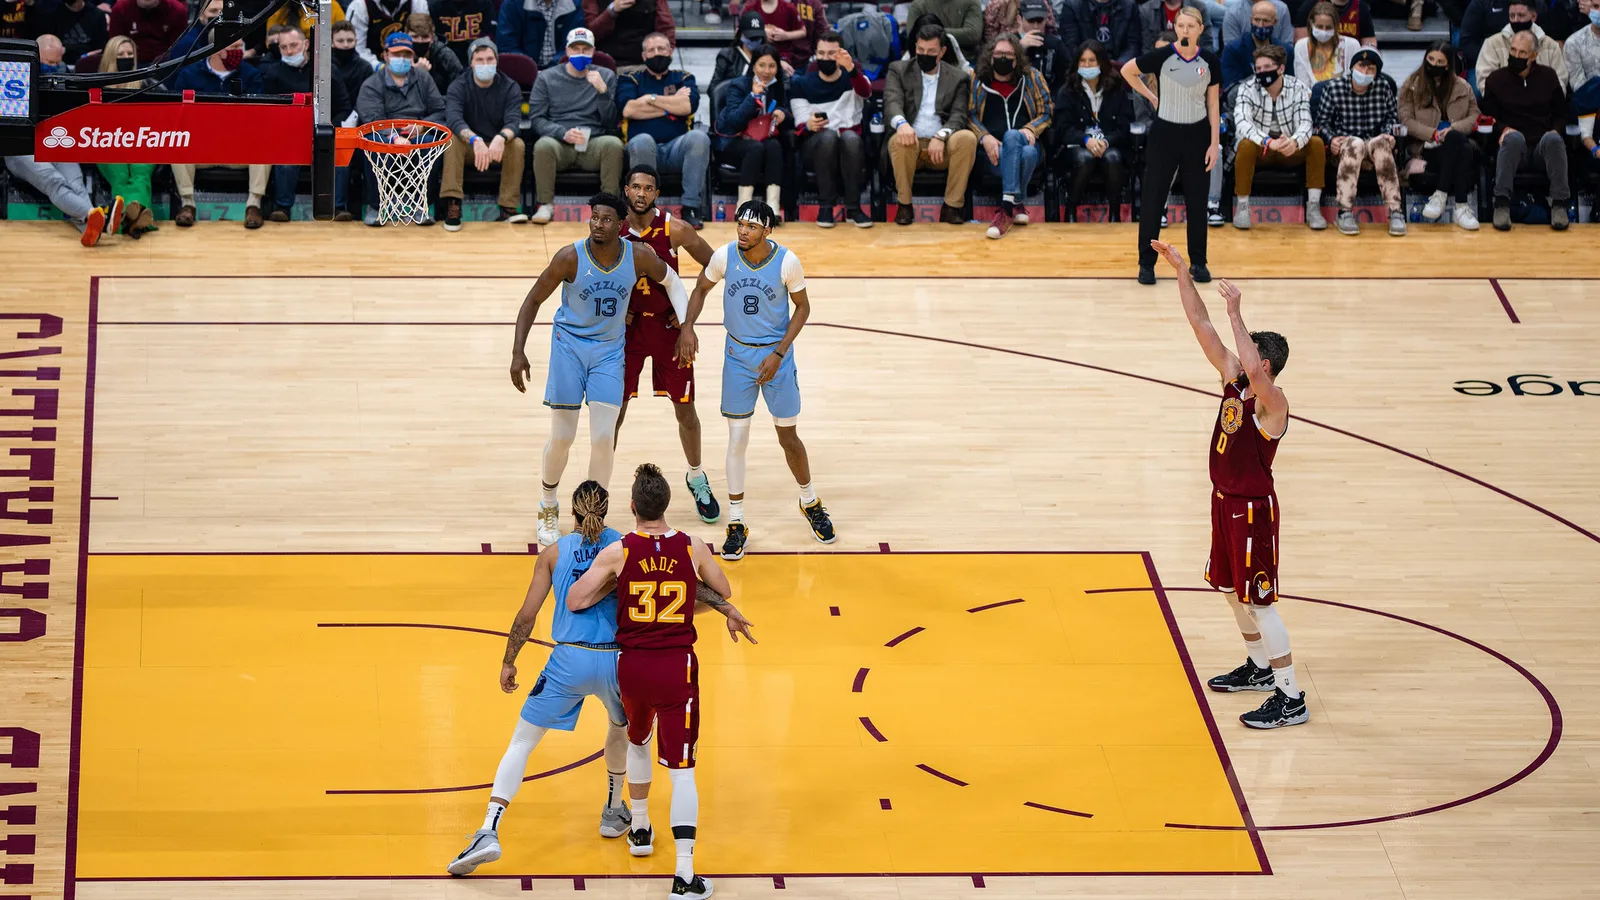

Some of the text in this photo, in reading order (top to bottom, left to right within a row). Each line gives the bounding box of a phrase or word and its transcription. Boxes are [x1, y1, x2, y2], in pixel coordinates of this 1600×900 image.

[439, 13, 483, 42] LE
[1337, 22, 1357, 36] LAND
[78, 126, 190, 148] State Farm
[579, 280, 629, 301] GRIZZLIES
[636, 277, 651, 295] 4
[728, 278, 777, 301] GRIZZLIES
[594, 297, 618, 317] 13
[743, 295, 760, 315] 8
[573, 546, 604, 563] CLARK
[638, 556, 678, 574] WADE
[628, 580, 687, 623] 32
